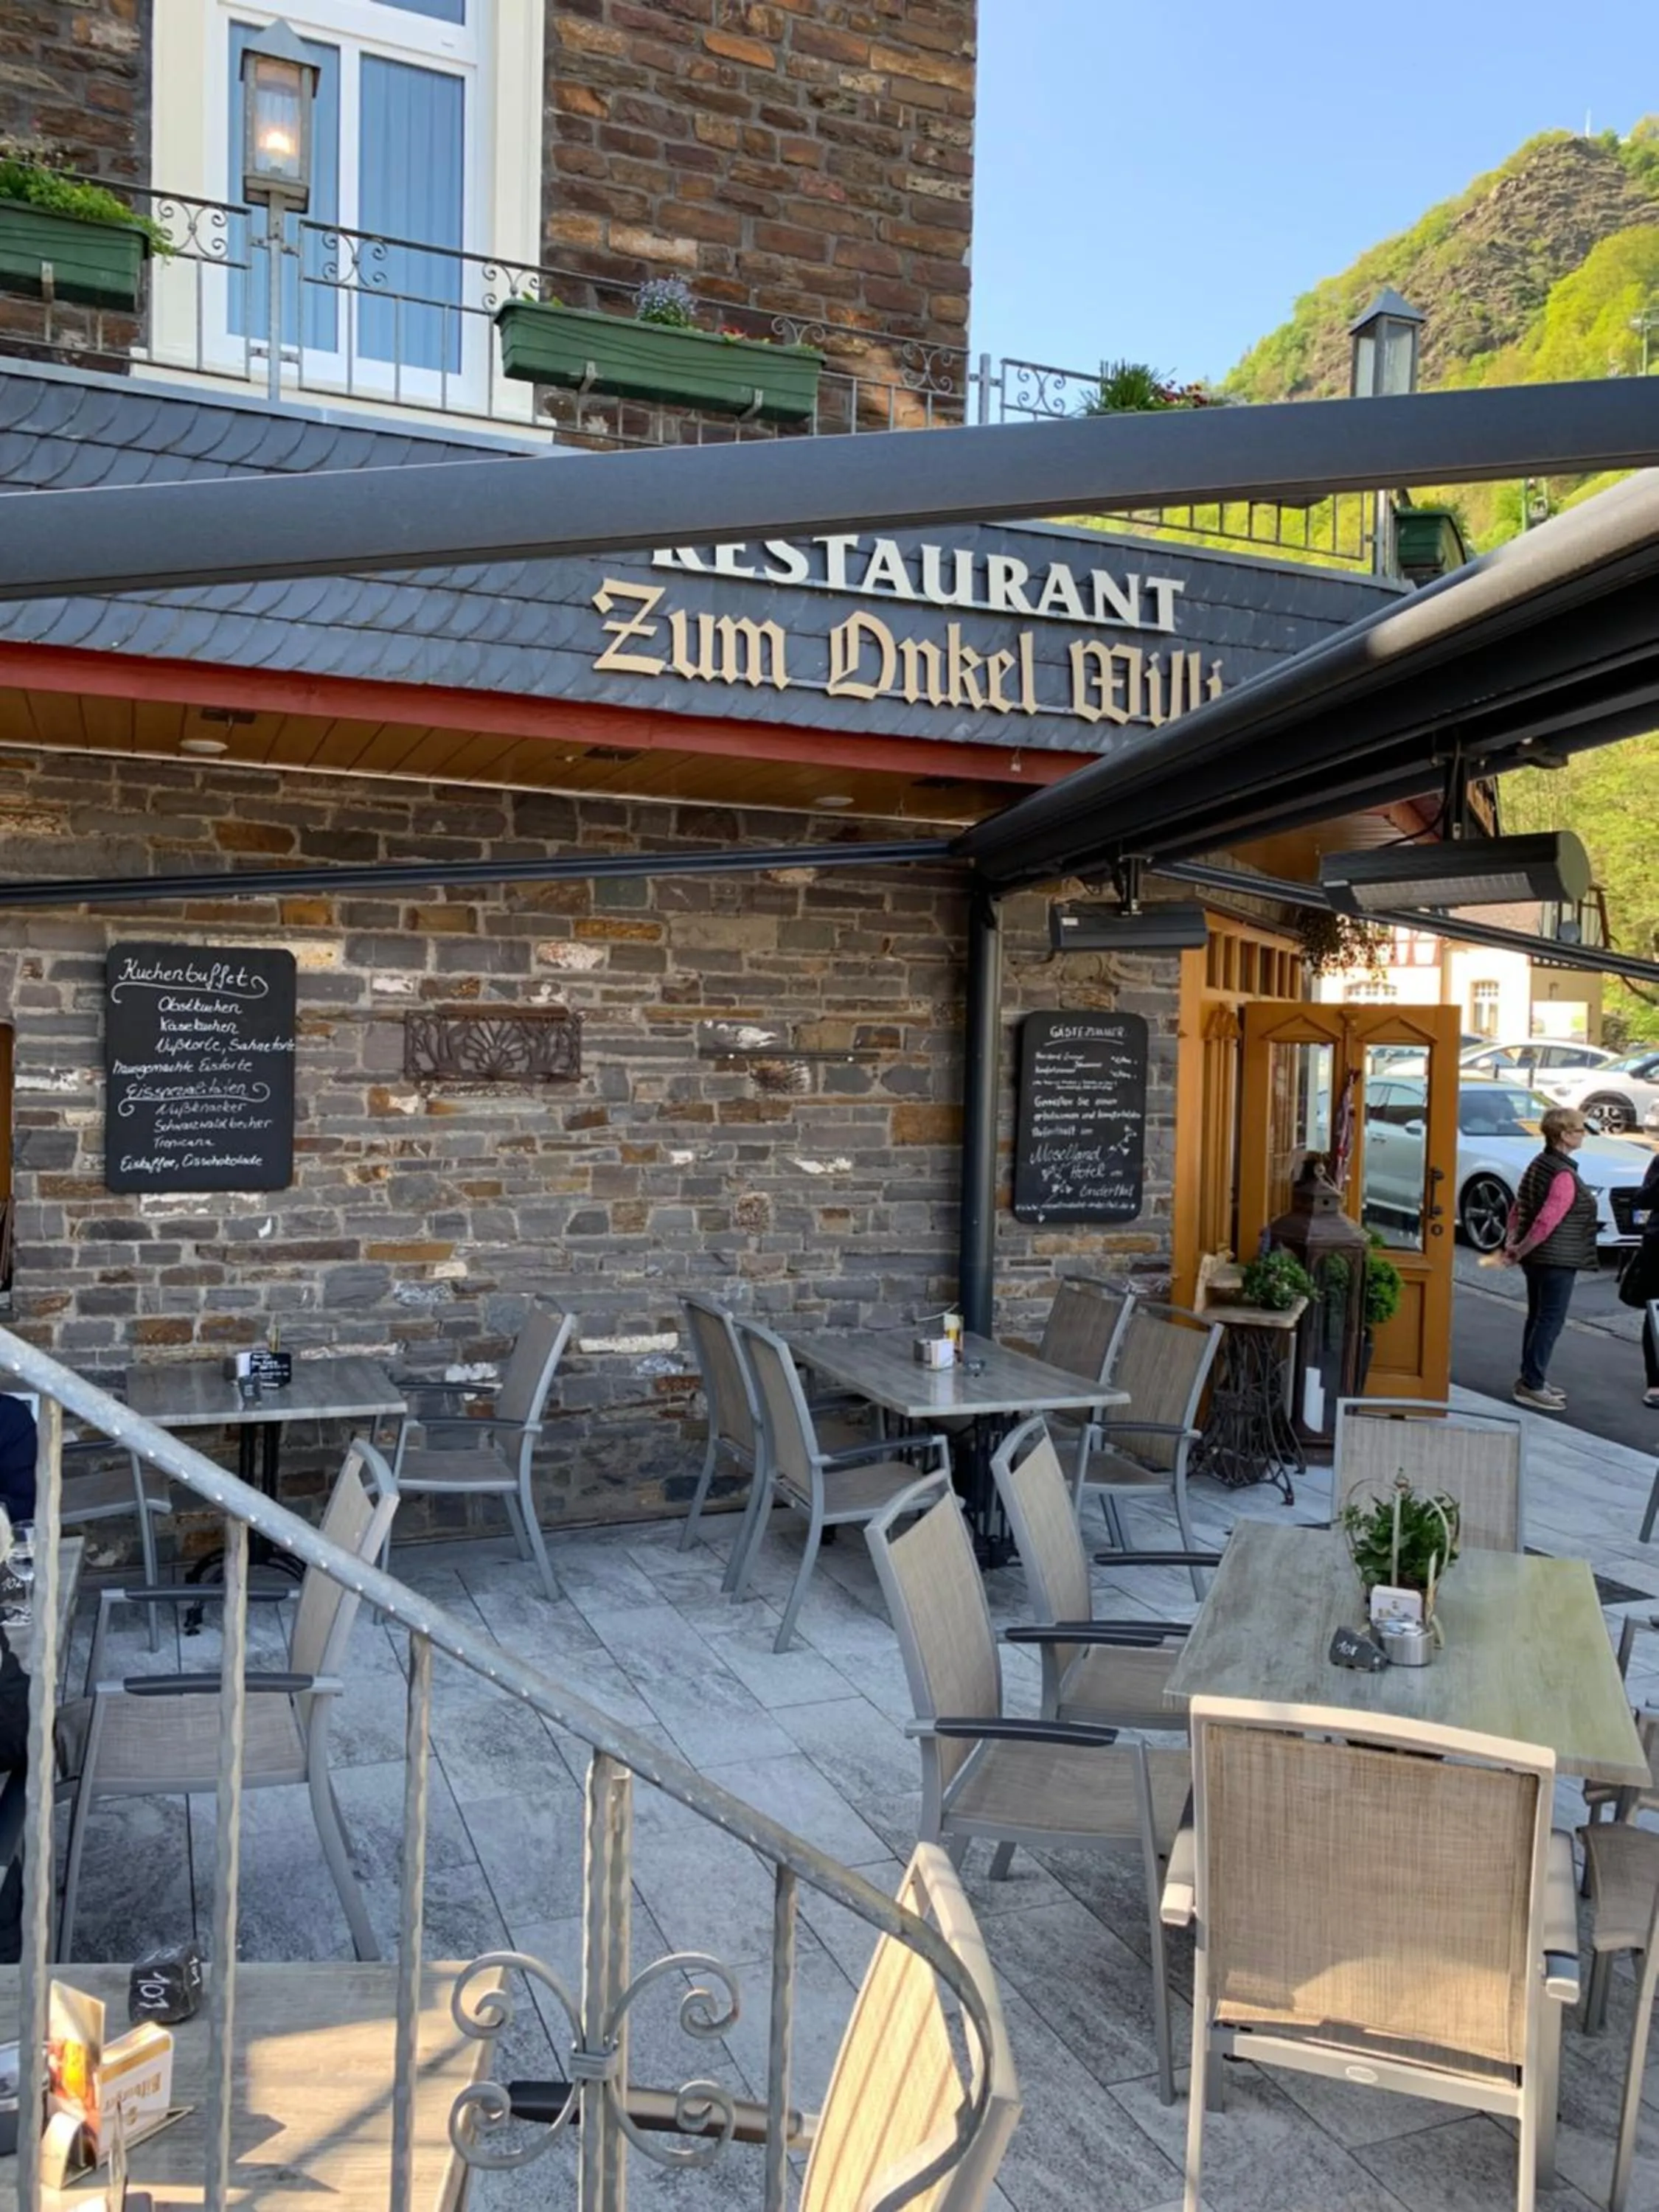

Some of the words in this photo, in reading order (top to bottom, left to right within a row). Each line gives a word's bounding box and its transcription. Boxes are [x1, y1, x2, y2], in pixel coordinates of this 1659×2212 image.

[591, 577, 791, 691] Zum
[826, 610, 1041, 715] Onkel
[1069, 639, 1224, 728] Willi
[118, 958, 249, 990] Kuchenbuffet
[137, 1972, 170, 2008] 101
